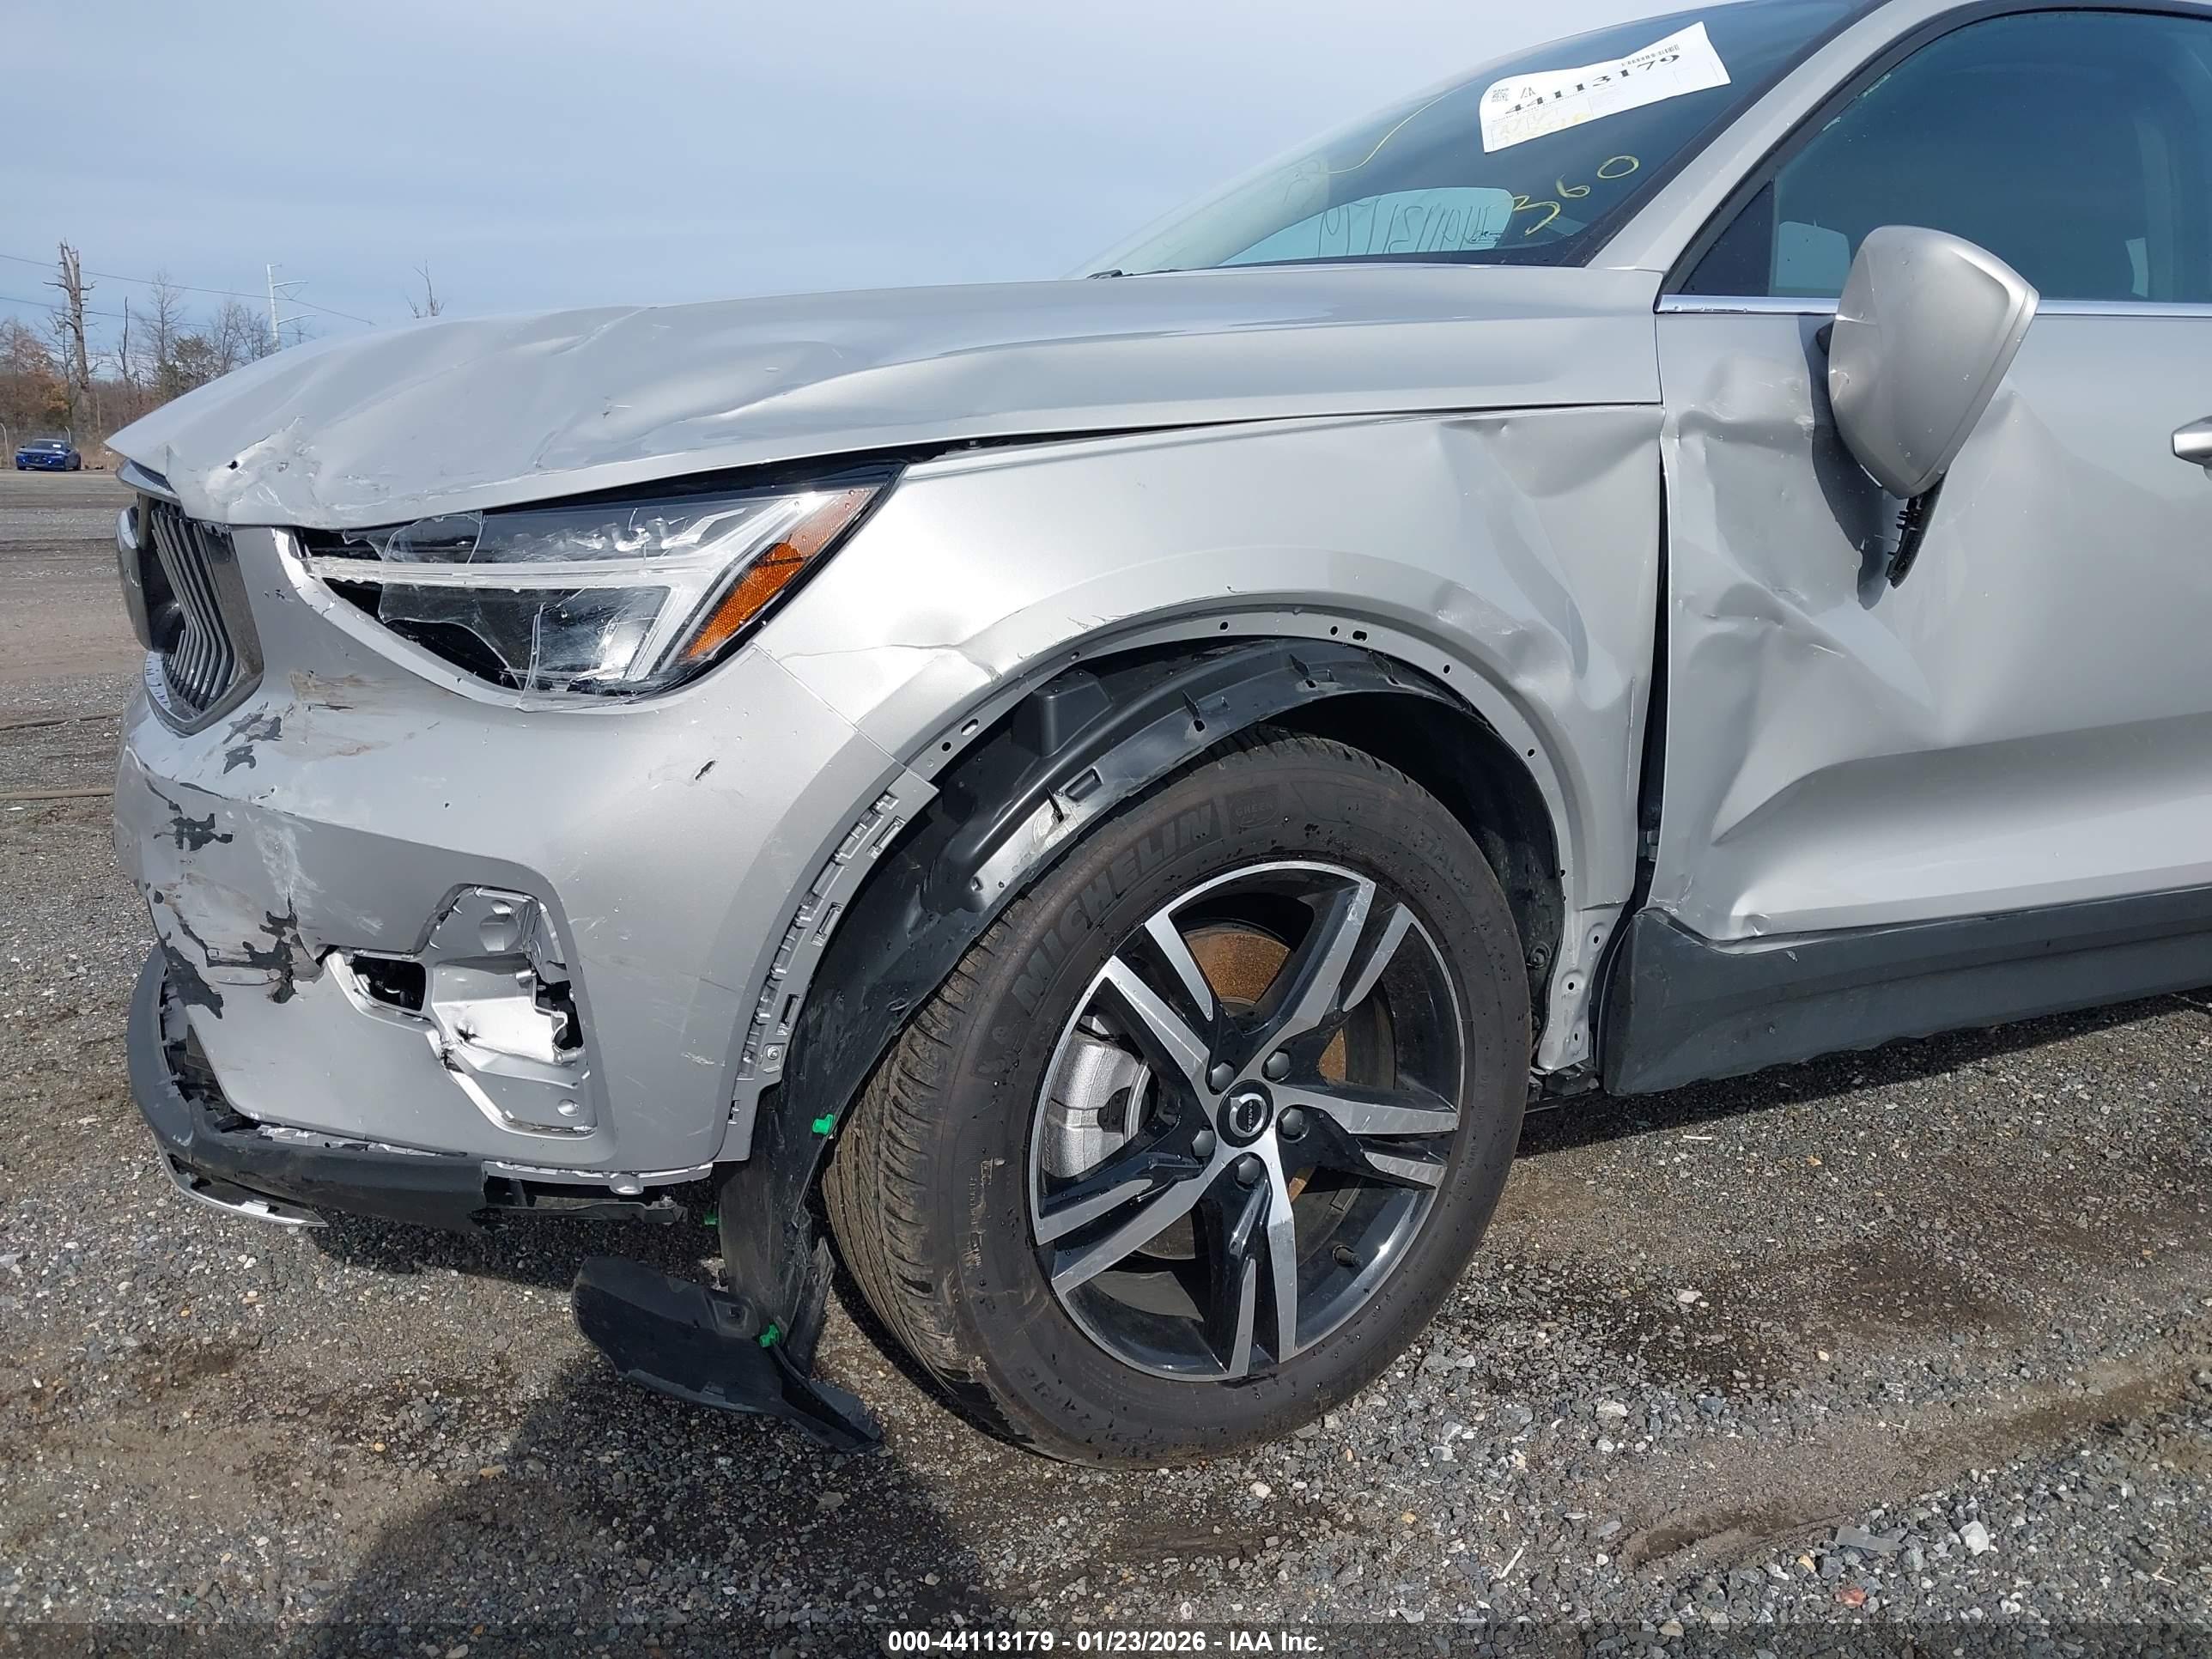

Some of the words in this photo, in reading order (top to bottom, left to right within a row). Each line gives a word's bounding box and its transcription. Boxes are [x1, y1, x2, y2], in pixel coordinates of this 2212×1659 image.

[1505, 54, 1680, 114] 44113179
[1512, 155, 1639, 236] 360
[1012, 800, 1213, 1012] MICHELIN
